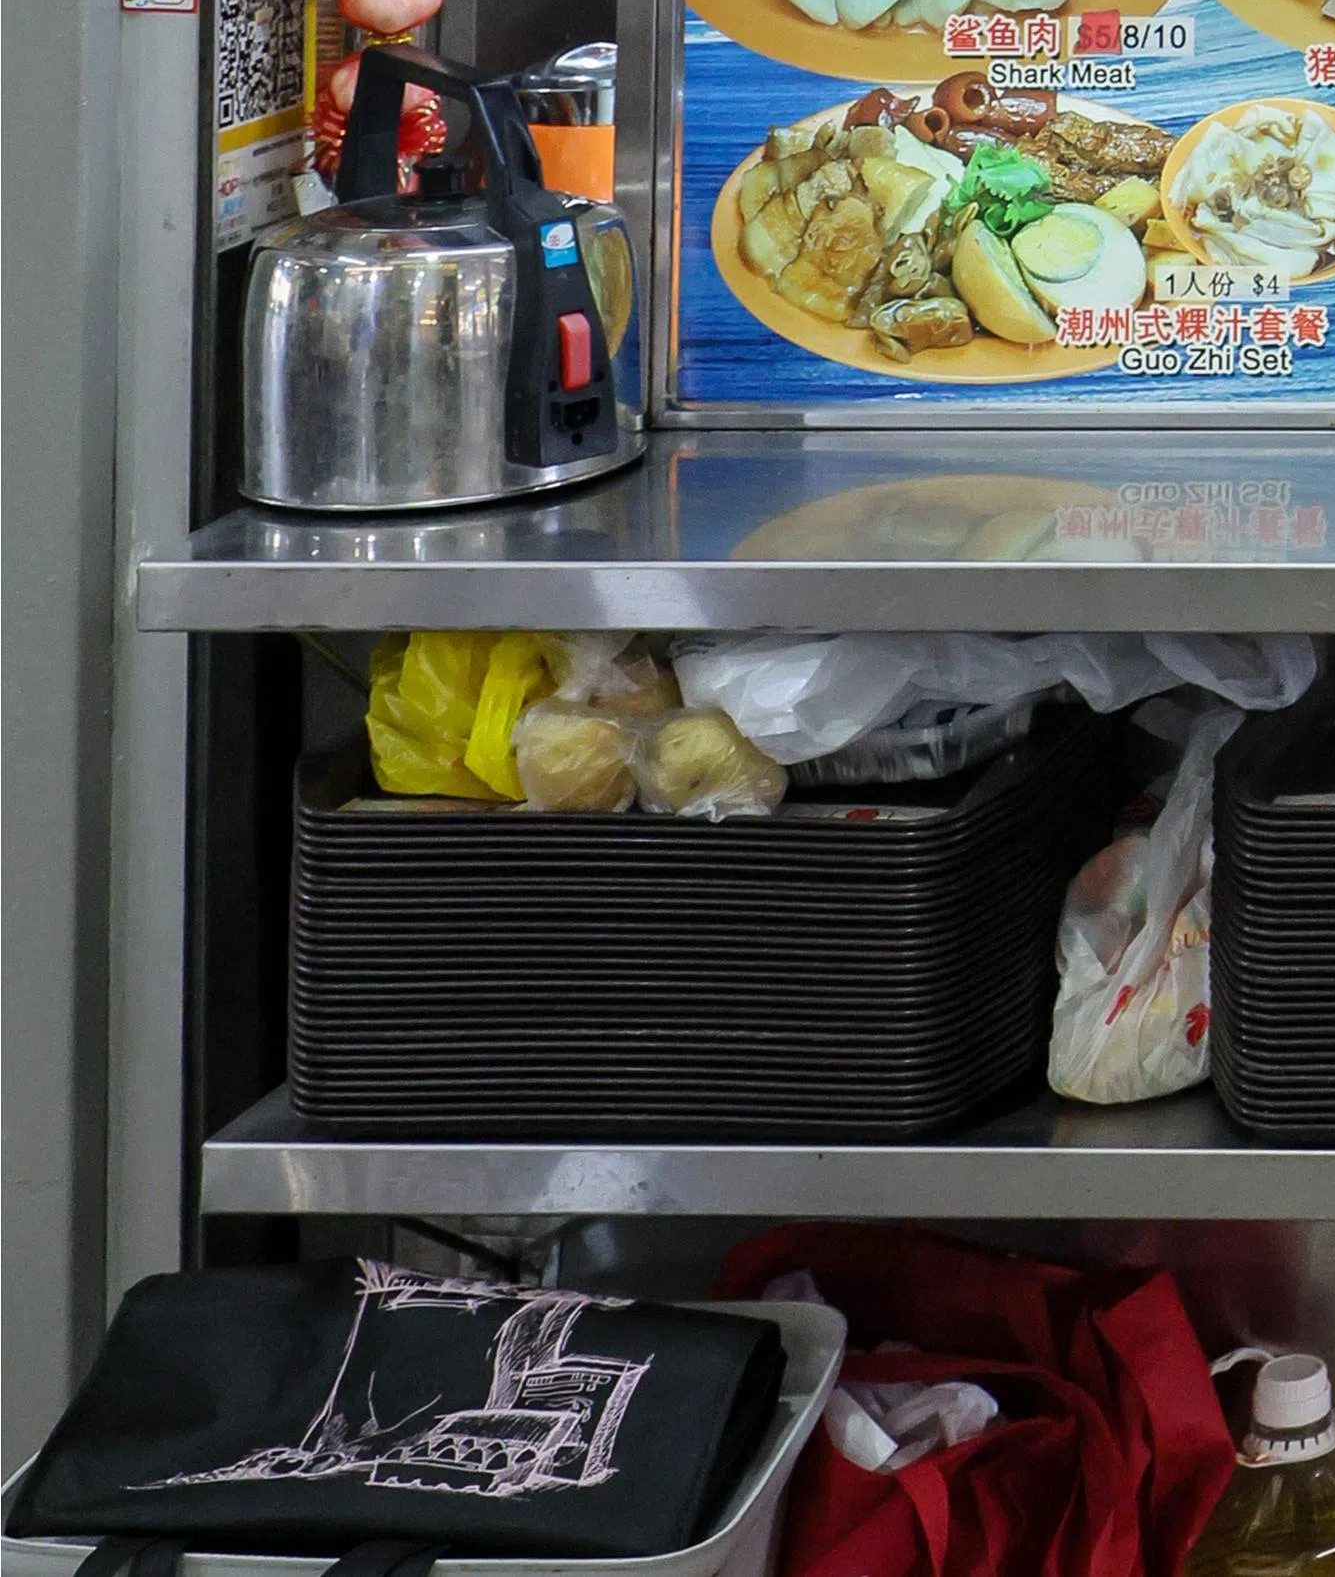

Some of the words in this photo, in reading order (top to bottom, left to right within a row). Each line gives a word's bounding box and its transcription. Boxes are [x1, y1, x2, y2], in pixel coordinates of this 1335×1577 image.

[944, 16, 1060, 57] 鲨鱼肉
[1076, 22, 1187, 52] $5/8/10
[990, 62, 1064, 86] Shark
[1071, 62, 1134, 86] Meat
[1164, 272, 1235, 298] 1人份
[1251, 272, 1281, 297] $4
[1058, 306, 1328, 344] 潮州式粿汁套餐
[1121, 348, 1178, 372] Guo
[1187, 348, 1235, 371] Zhi
[1242, 348, 1290, 371] Set
